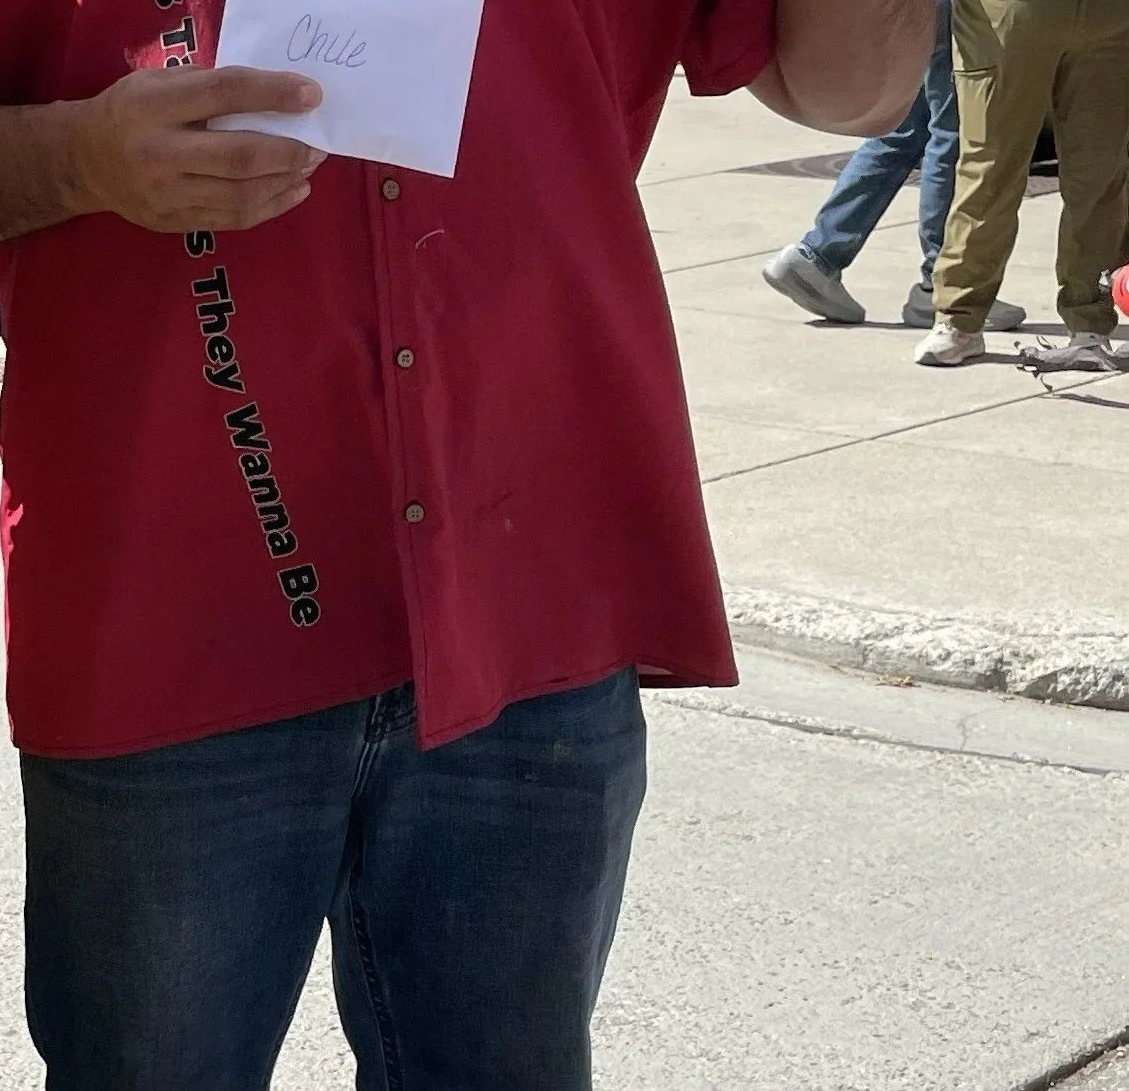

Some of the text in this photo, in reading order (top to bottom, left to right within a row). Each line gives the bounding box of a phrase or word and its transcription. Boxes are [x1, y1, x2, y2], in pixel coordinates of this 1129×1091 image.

[191, 265, 246, 393] They
[224, 401, 299, 559] Wanna
[277, 563, 321, 627] Be
